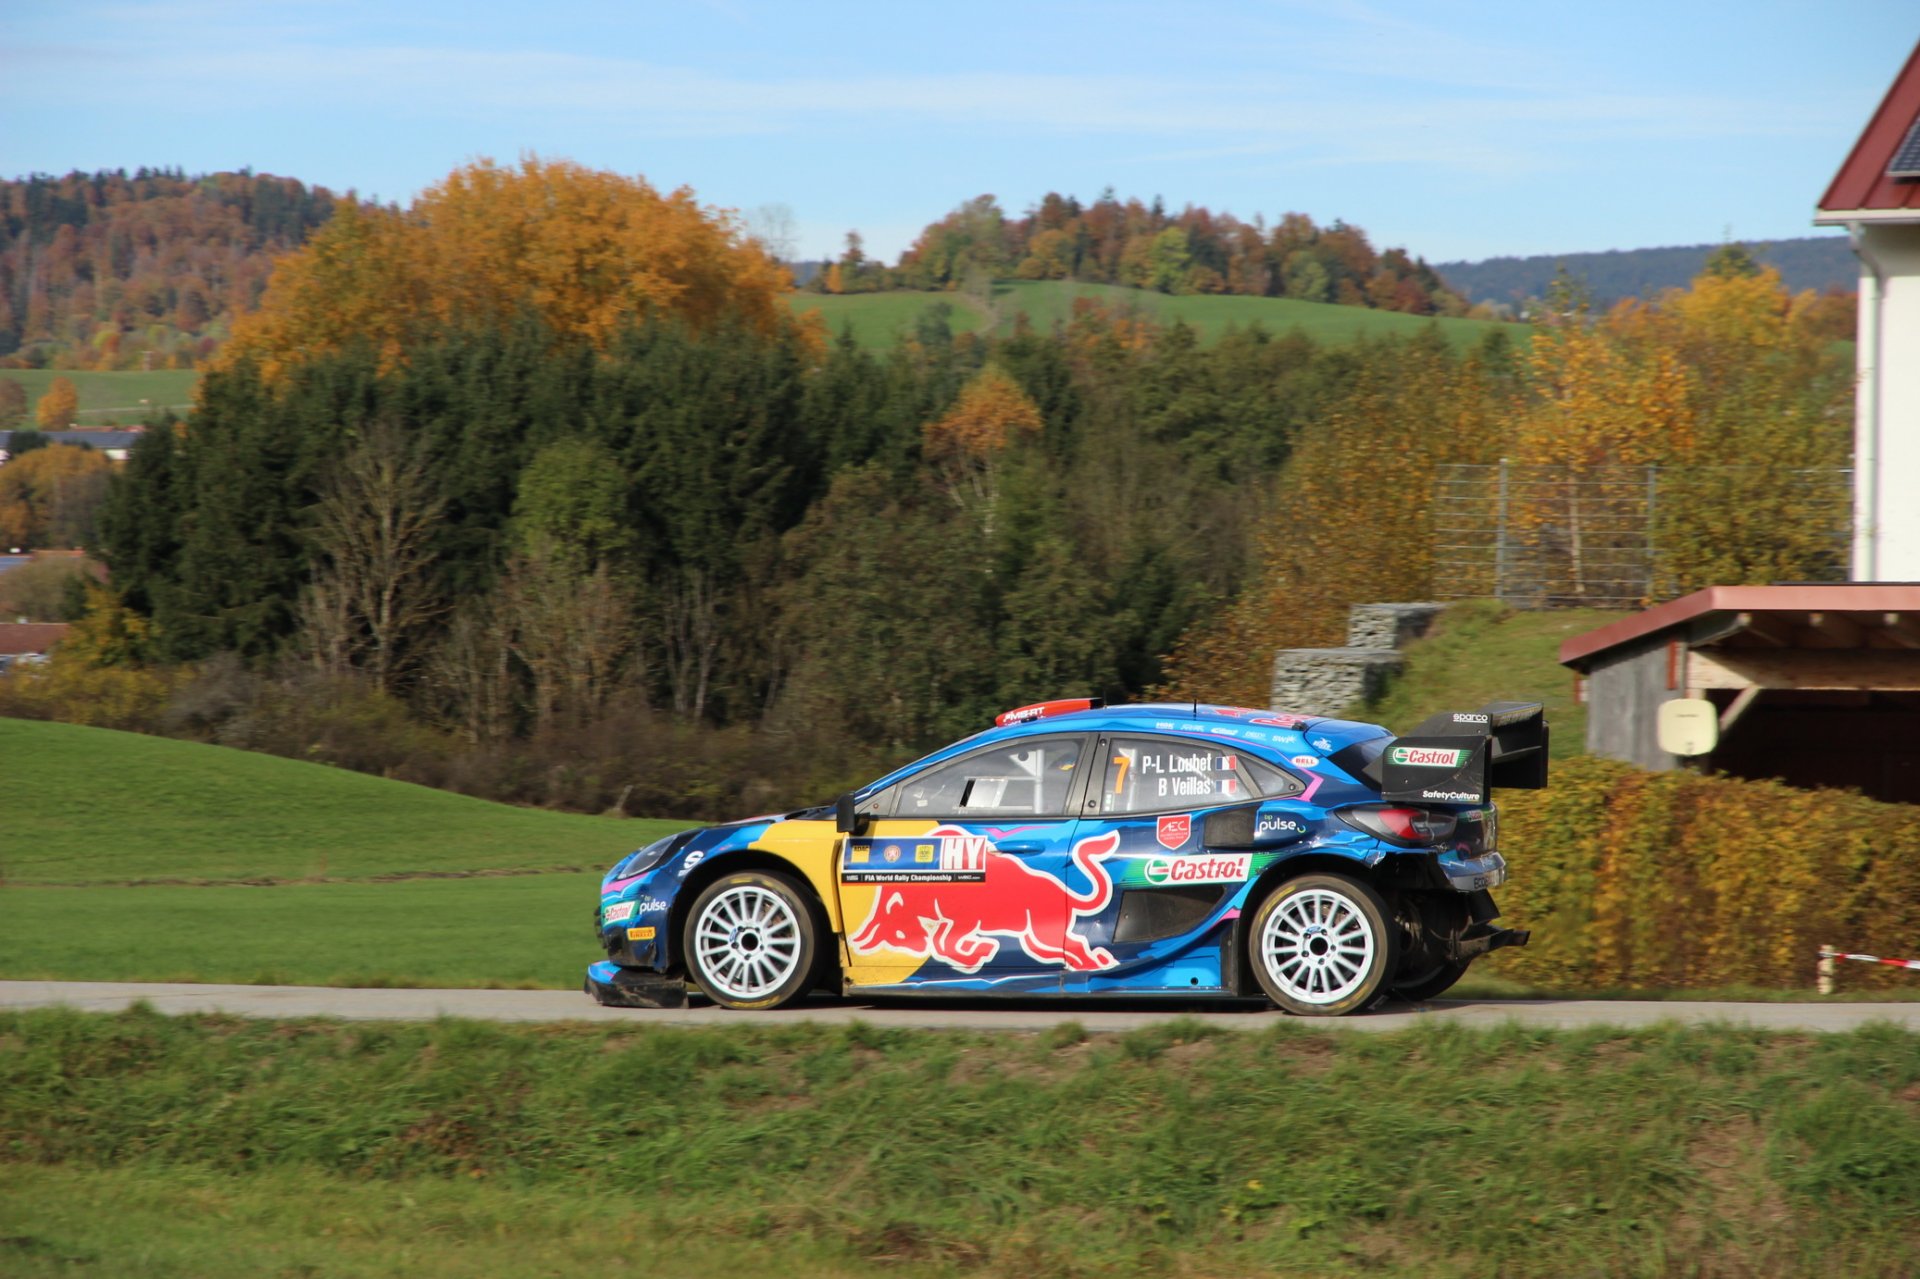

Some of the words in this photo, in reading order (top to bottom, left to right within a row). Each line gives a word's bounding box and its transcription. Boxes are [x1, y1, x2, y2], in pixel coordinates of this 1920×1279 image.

[1453, 713, 1488, 722] sparco
[1142, 755, 1165, 774] P-L
[1169, 753, 1212, 773] Loubet
[1409, 749, 1455, 764] Castrol
[1113, 756, 1131, 794] 7
[1158, 778, 1167, 797] B
[1171, 776, 1211, 796] Veillas
[1422, 790, 1480, 800] SafetyCulture
[1160, 820, 1188, 832] AEC
[1259, 817, 1296, 834] pulse
[943, 838, 984, 870] HY
[1171, 857, 1244, 880] Castrol
[640, 899, 667, 915] pulse
